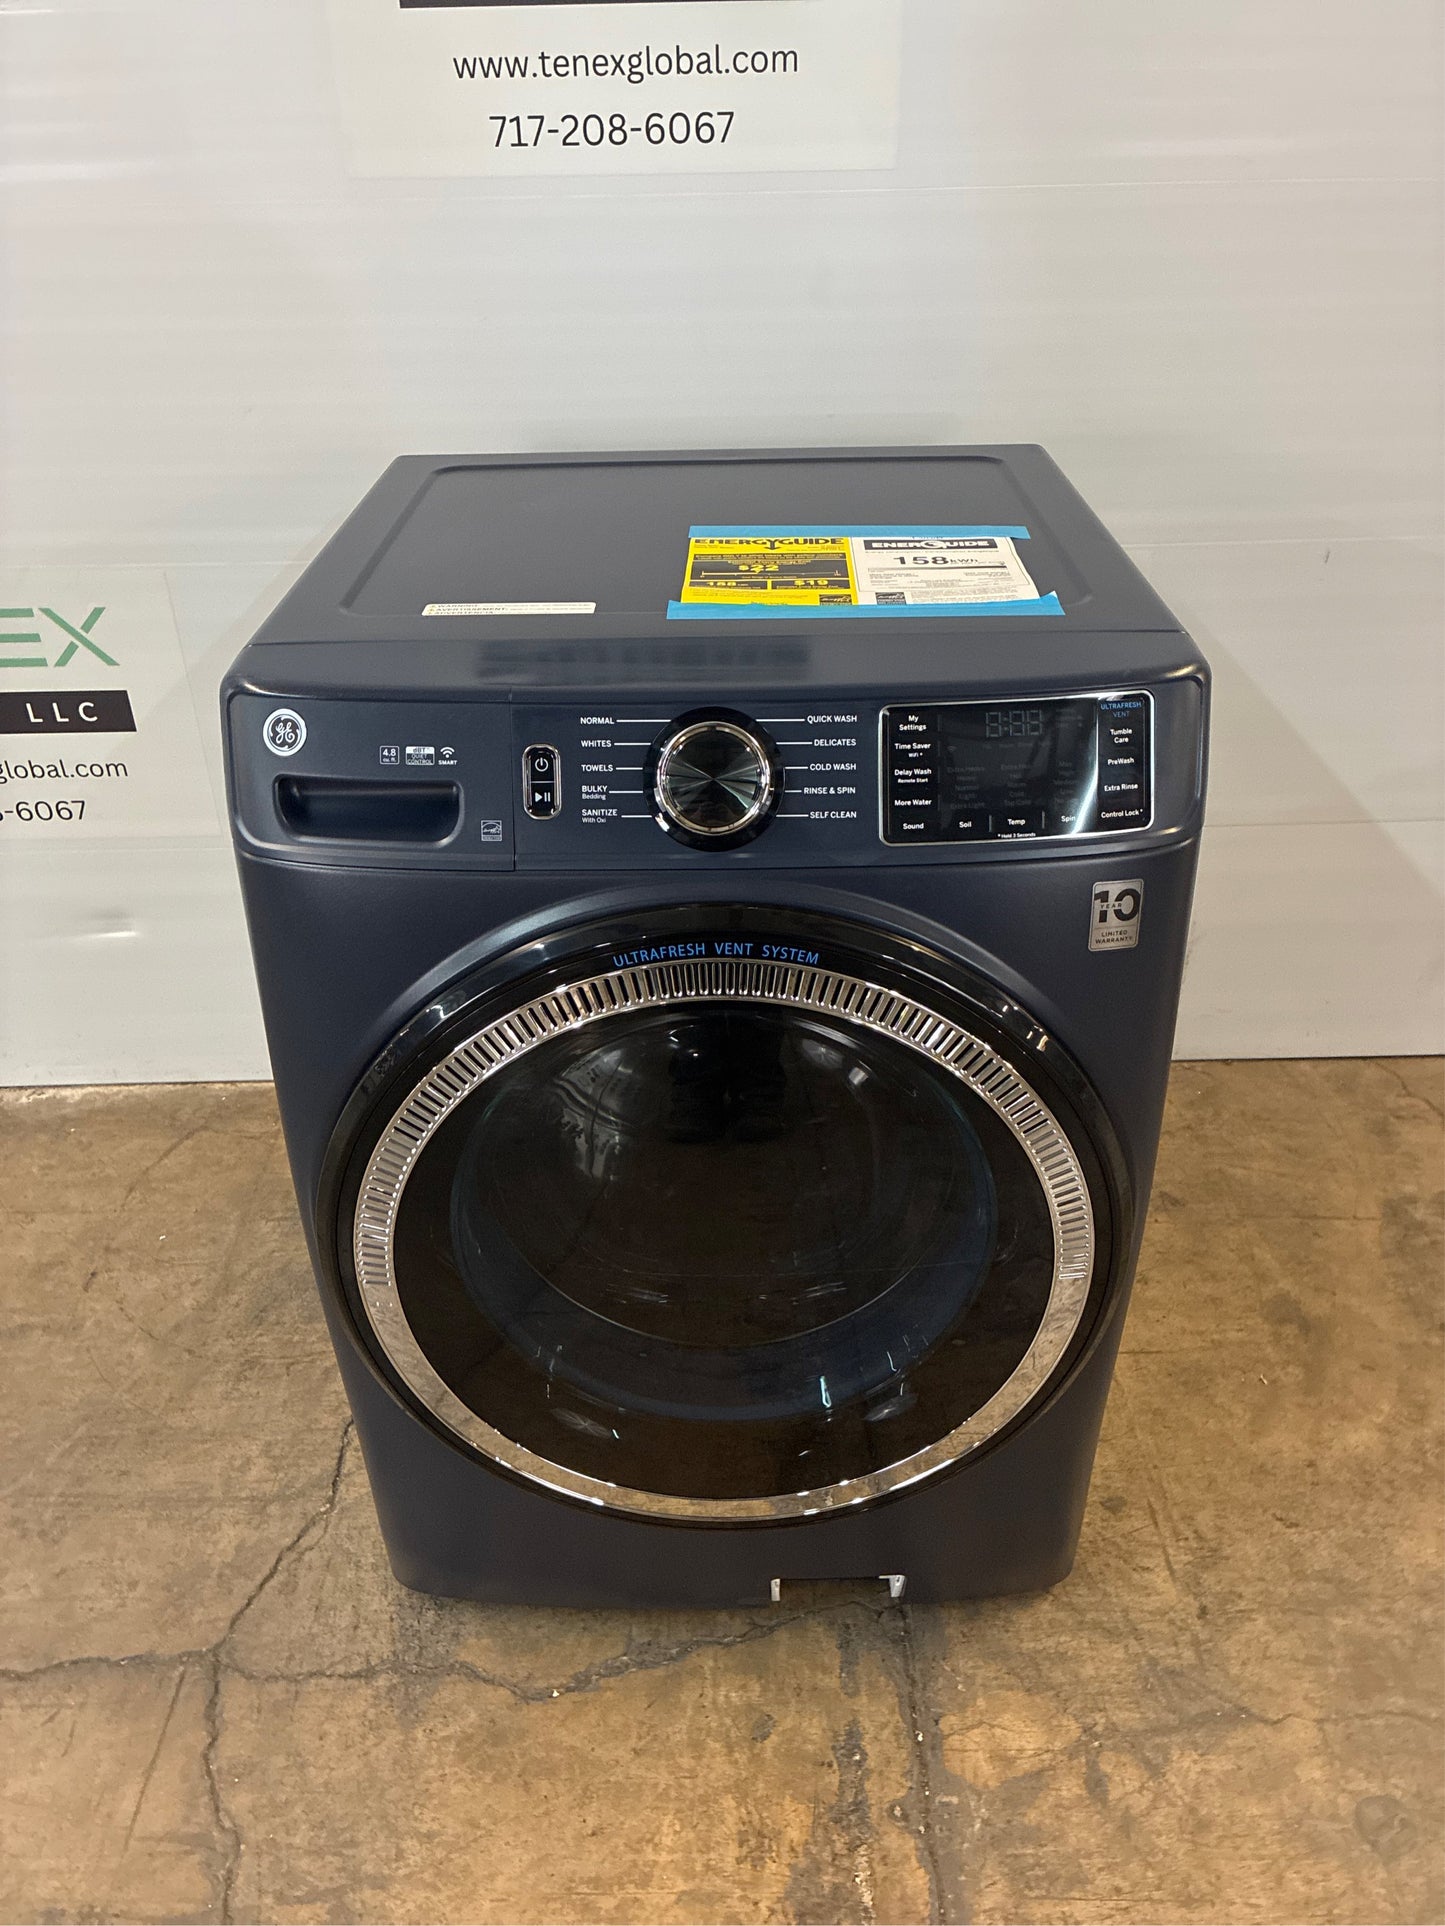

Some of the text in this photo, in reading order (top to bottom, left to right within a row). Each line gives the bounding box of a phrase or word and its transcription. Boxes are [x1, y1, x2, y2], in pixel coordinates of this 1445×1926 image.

[453, 44, 799, 84] www.tenexglobal.com
[488, 111, 736, 147] 717-208-6067
[893, 556, 949, 565] 158
[1100, 702, 1142, 710] ULTRAFRESH
[25, 702, 98, 722] LLC
[580, 716, 615, 725] NORMAL
[806, 714, 858, 724] QUICK WASH
[908, 715, 919, 723] My
[899, 724, 927, 732] Settings
[1110, 728, 1133, 736] Tumble
[580, 739, 612, 748] WHITES
[813, 738, 857, 747] DELICATES
[912, 742, 931, 750] Saver
[382, 748, 397, 757] 4.8
[1107, 757, 1135, 766] PreWash
[580, 764, 614, 772] TOWELS
[809, 762, 857, 771] COLD WASH
[894, 768, 932, 777] Delay Wash
[581, 785, 608, 793] BULKY
[803, 786, 856, 795] RINSE & SPIN
[1104, 783, 1139, 792] Extra Rinse
[581, 808, 618, 817] SANITIZE
[809, 810, 857, 820] SELF CLEAN
[1101, 810, 1124, 819] Control
[1007, 818, 1026, 826] Temp
[1061, 815, 1076, 823] Spin
[902, 822, 925, 830] Sound
[1094, 888, 1142, 923] 10
[1101, 929, 1128, 937] LIMITED
[613, 942, 820, 967] ULTRAFRESH VENT SYSTEM
